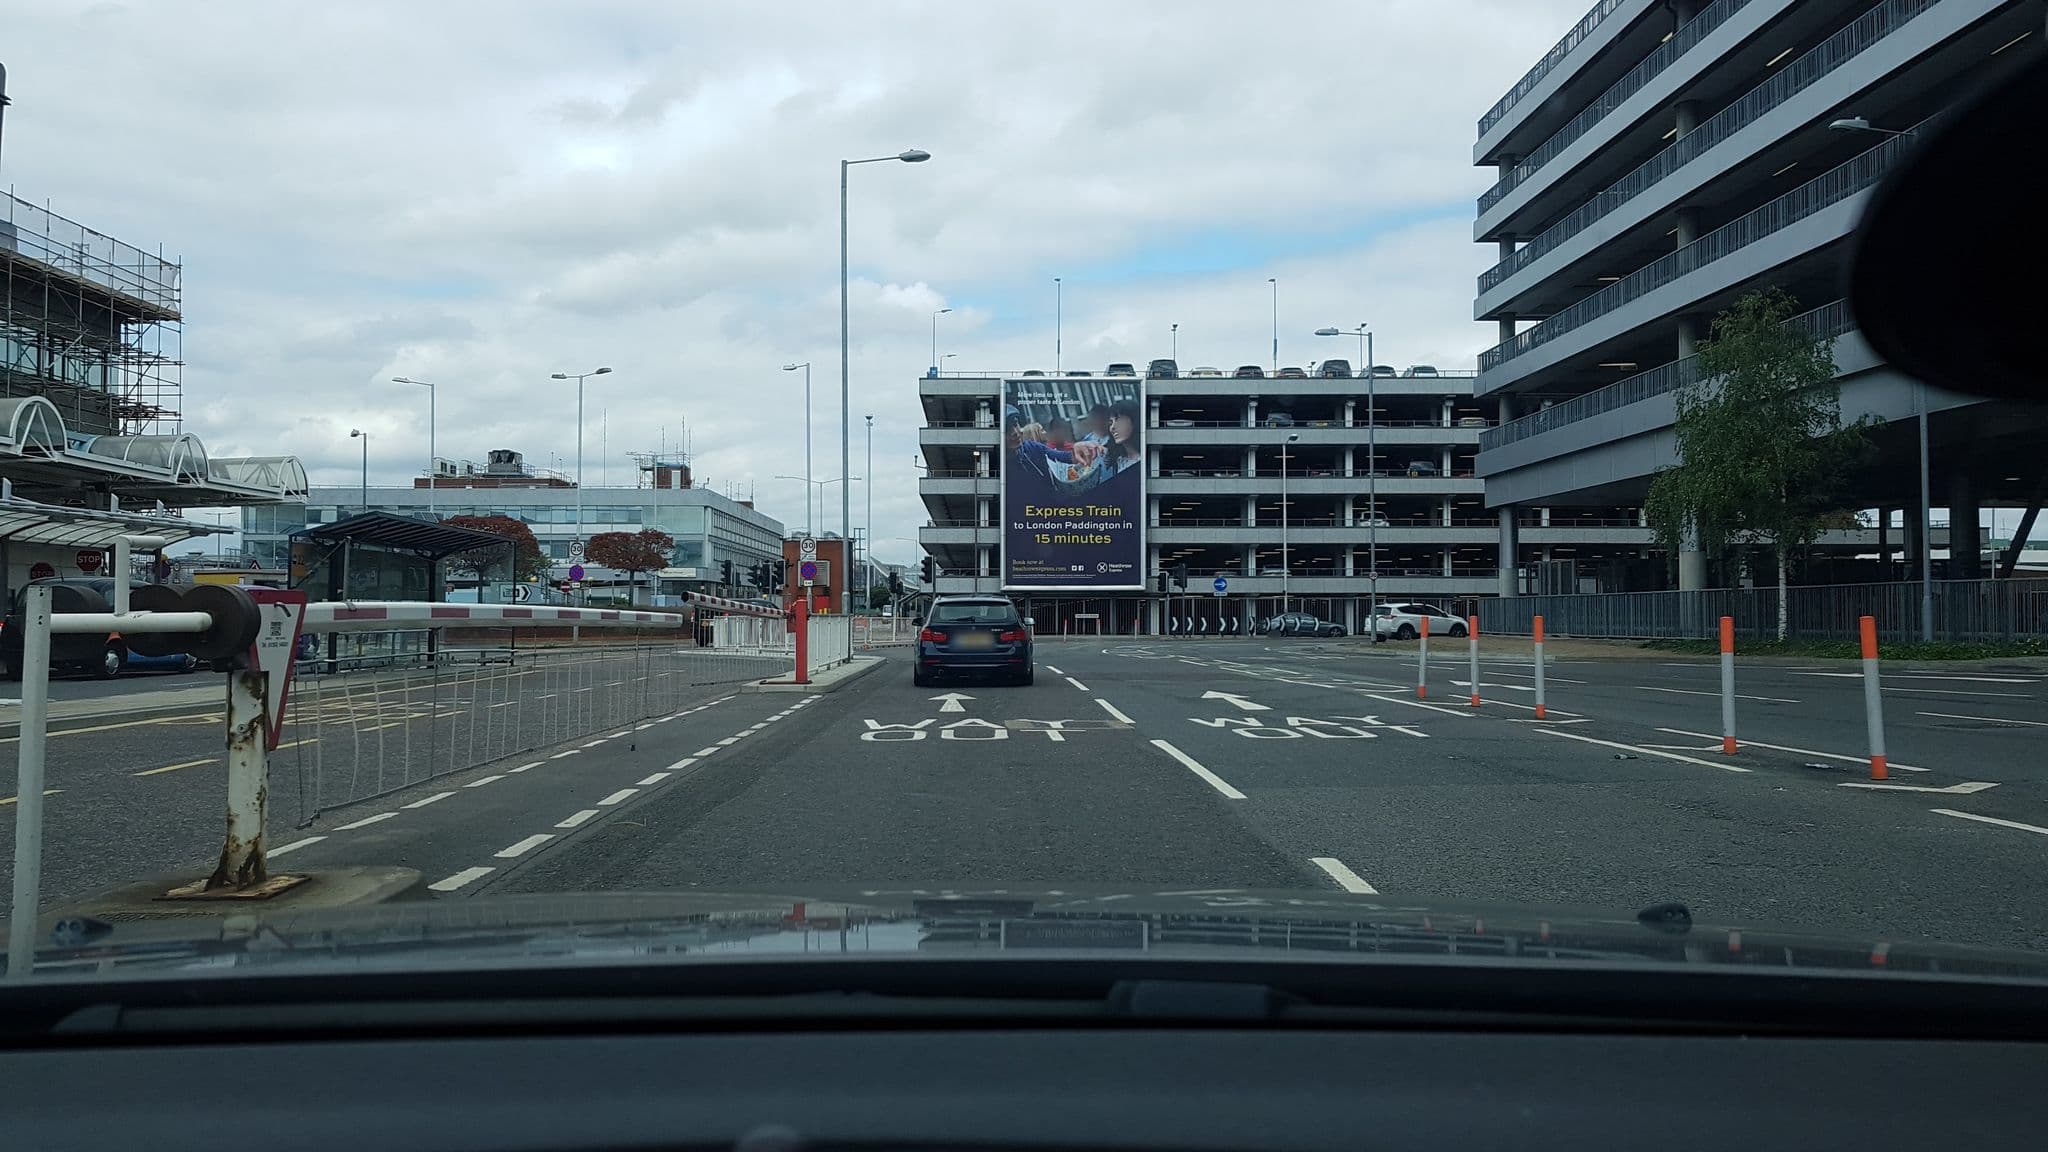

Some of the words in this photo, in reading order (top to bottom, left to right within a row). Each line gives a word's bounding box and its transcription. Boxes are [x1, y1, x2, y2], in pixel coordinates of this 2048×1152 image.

[1025, 505, 1083, 518] Express
[1086, 504, 1121, 517] Train
[1014, 521, 1024, 530] to
[1026, 521, 1062, 530] London
[1065, 521, 1121, 531] Paddington
[1123, 519, 1133, 530] in
[1034, 533, 1050, 544] 15
[1054, 532, 1112, 544] minutes
[77, 555, 101, 563] STOP
[863, 718, 1075, 730] WAY
[1187, 715, 1386, 728] WAY
[860, 728, 1088, 742] OUT
[1231, 725, 1431, 739] OUT
